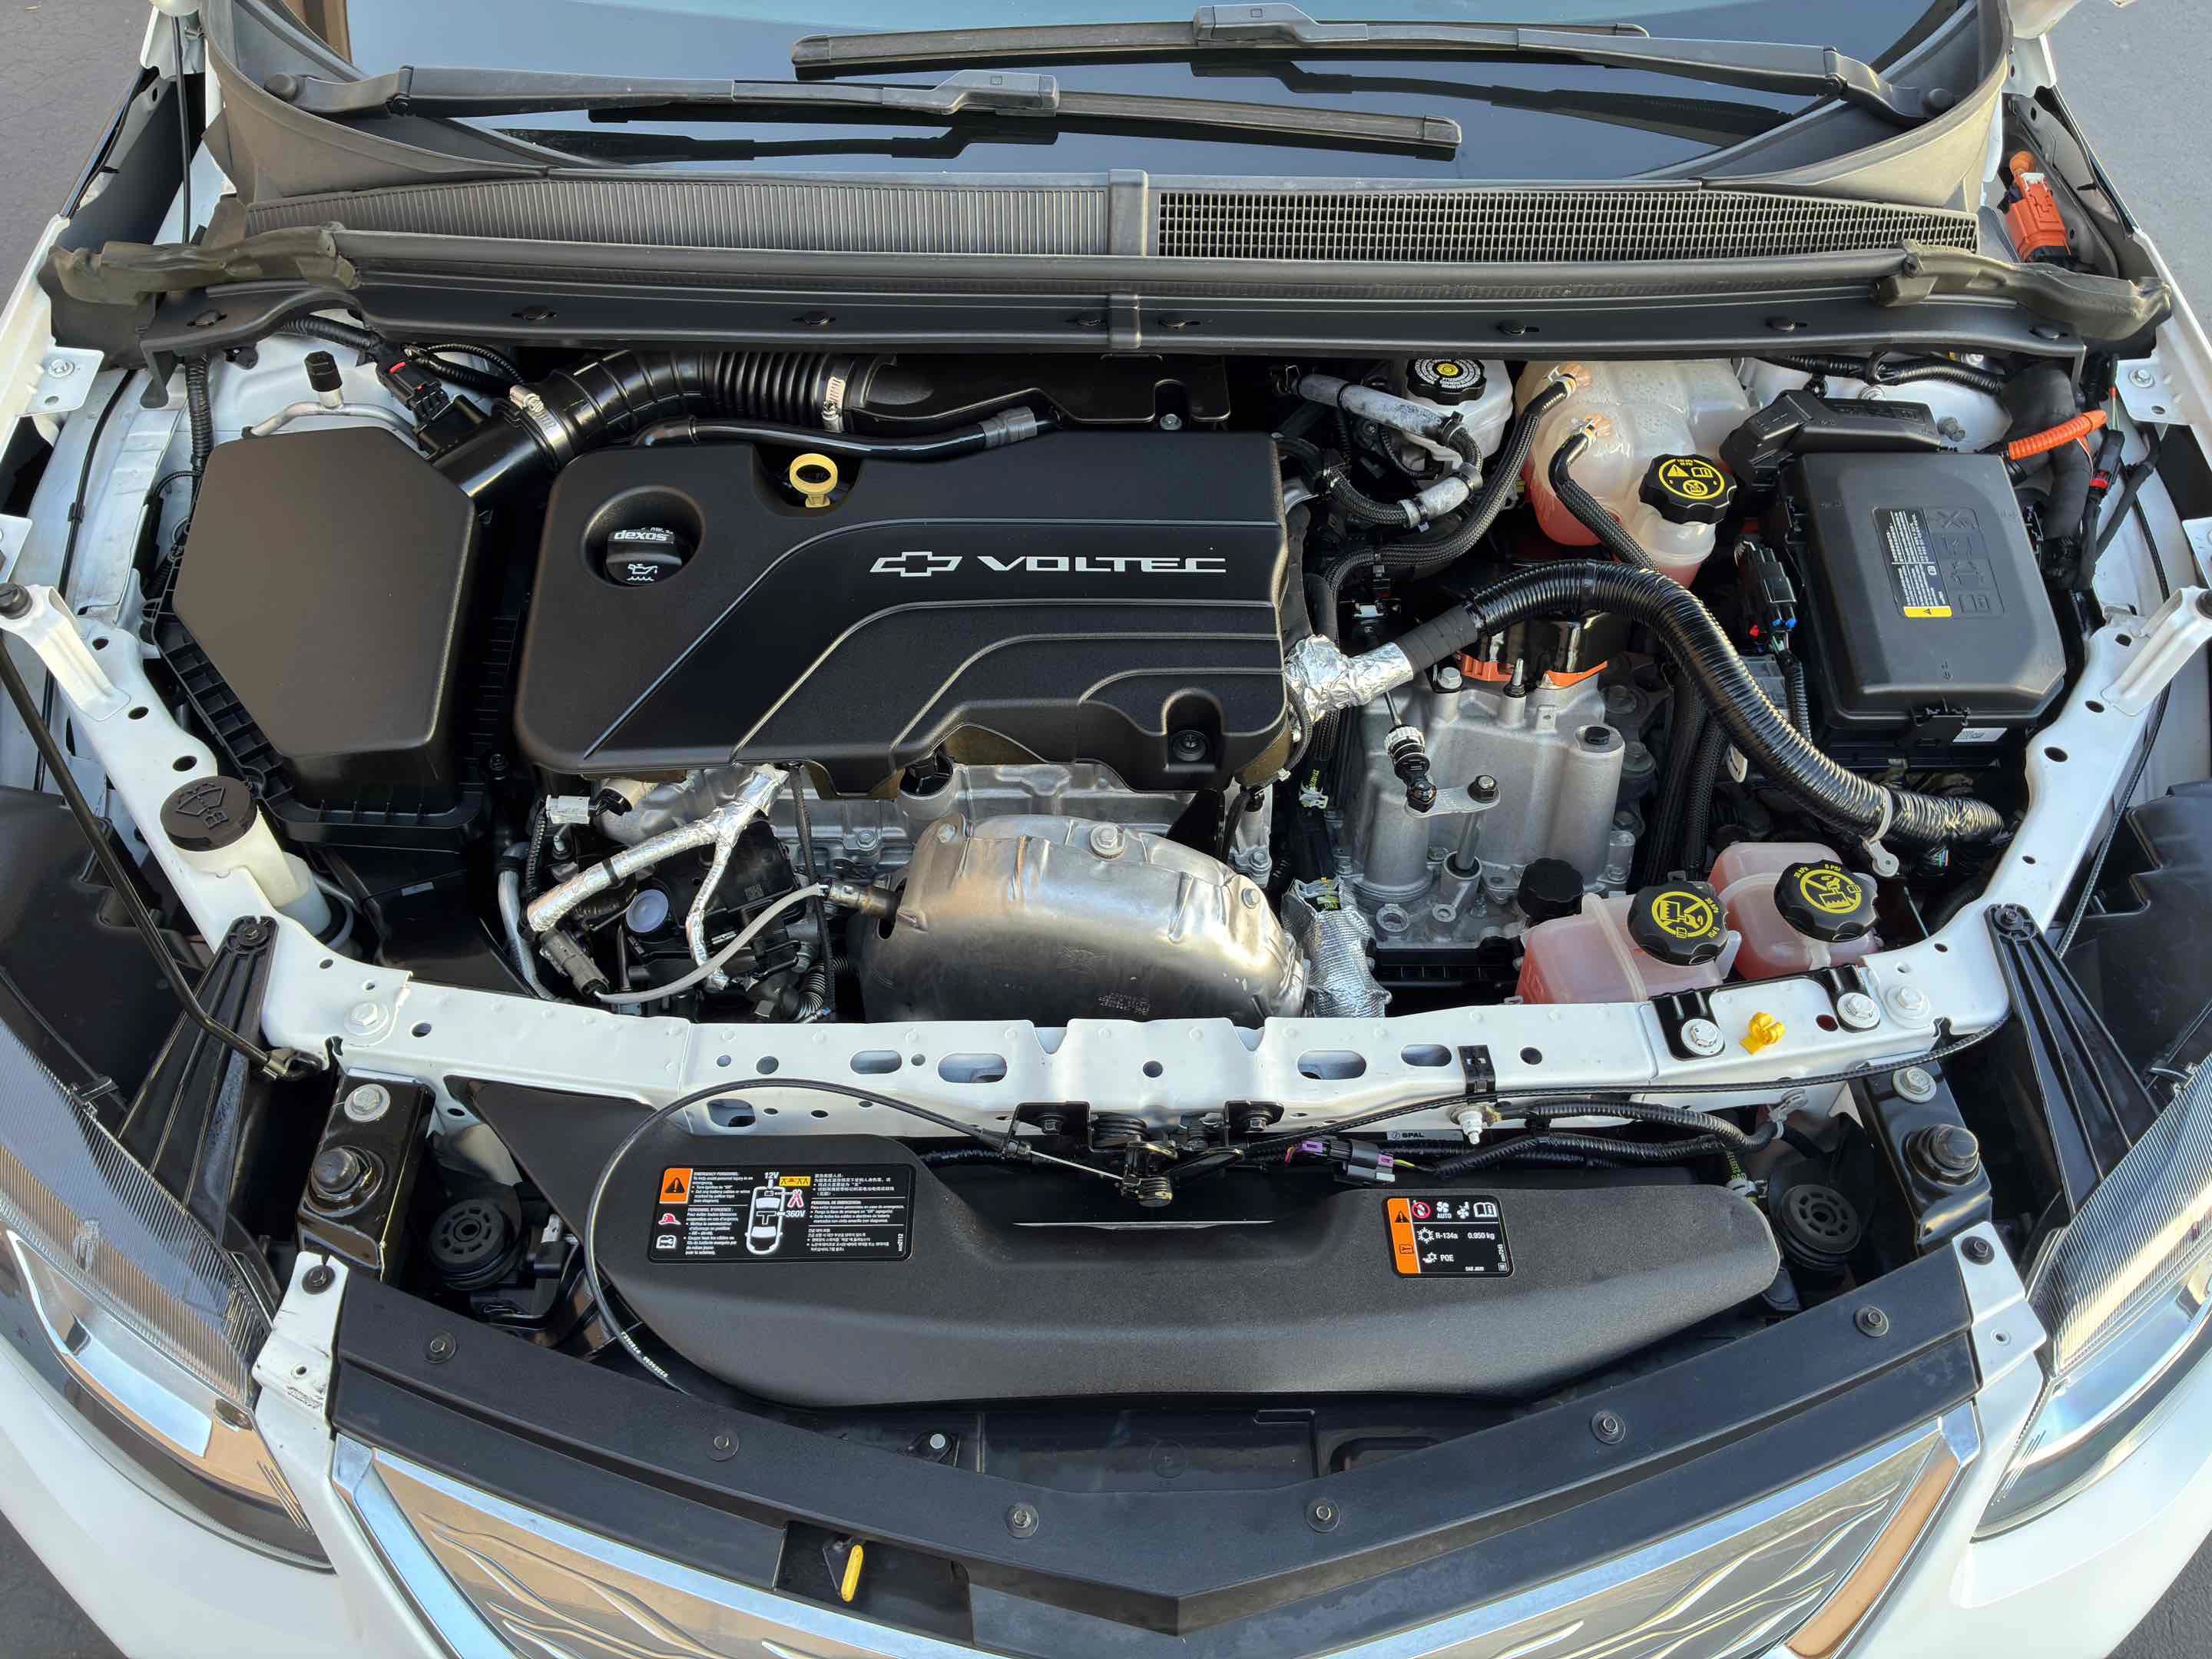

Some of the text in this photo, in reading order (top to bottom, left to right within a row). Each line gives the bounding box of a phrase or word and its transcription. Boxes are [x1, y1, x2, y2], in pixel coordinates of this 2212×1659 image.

[614, 530, 671, 541] dexos
[977, 555, 1227, 573] VOLTEC
[786, 1210, 806, 1218] 360V
[1435, 1231, 1459, 1240] R-134a
[1486, 1231, 1495, 1240] kg
